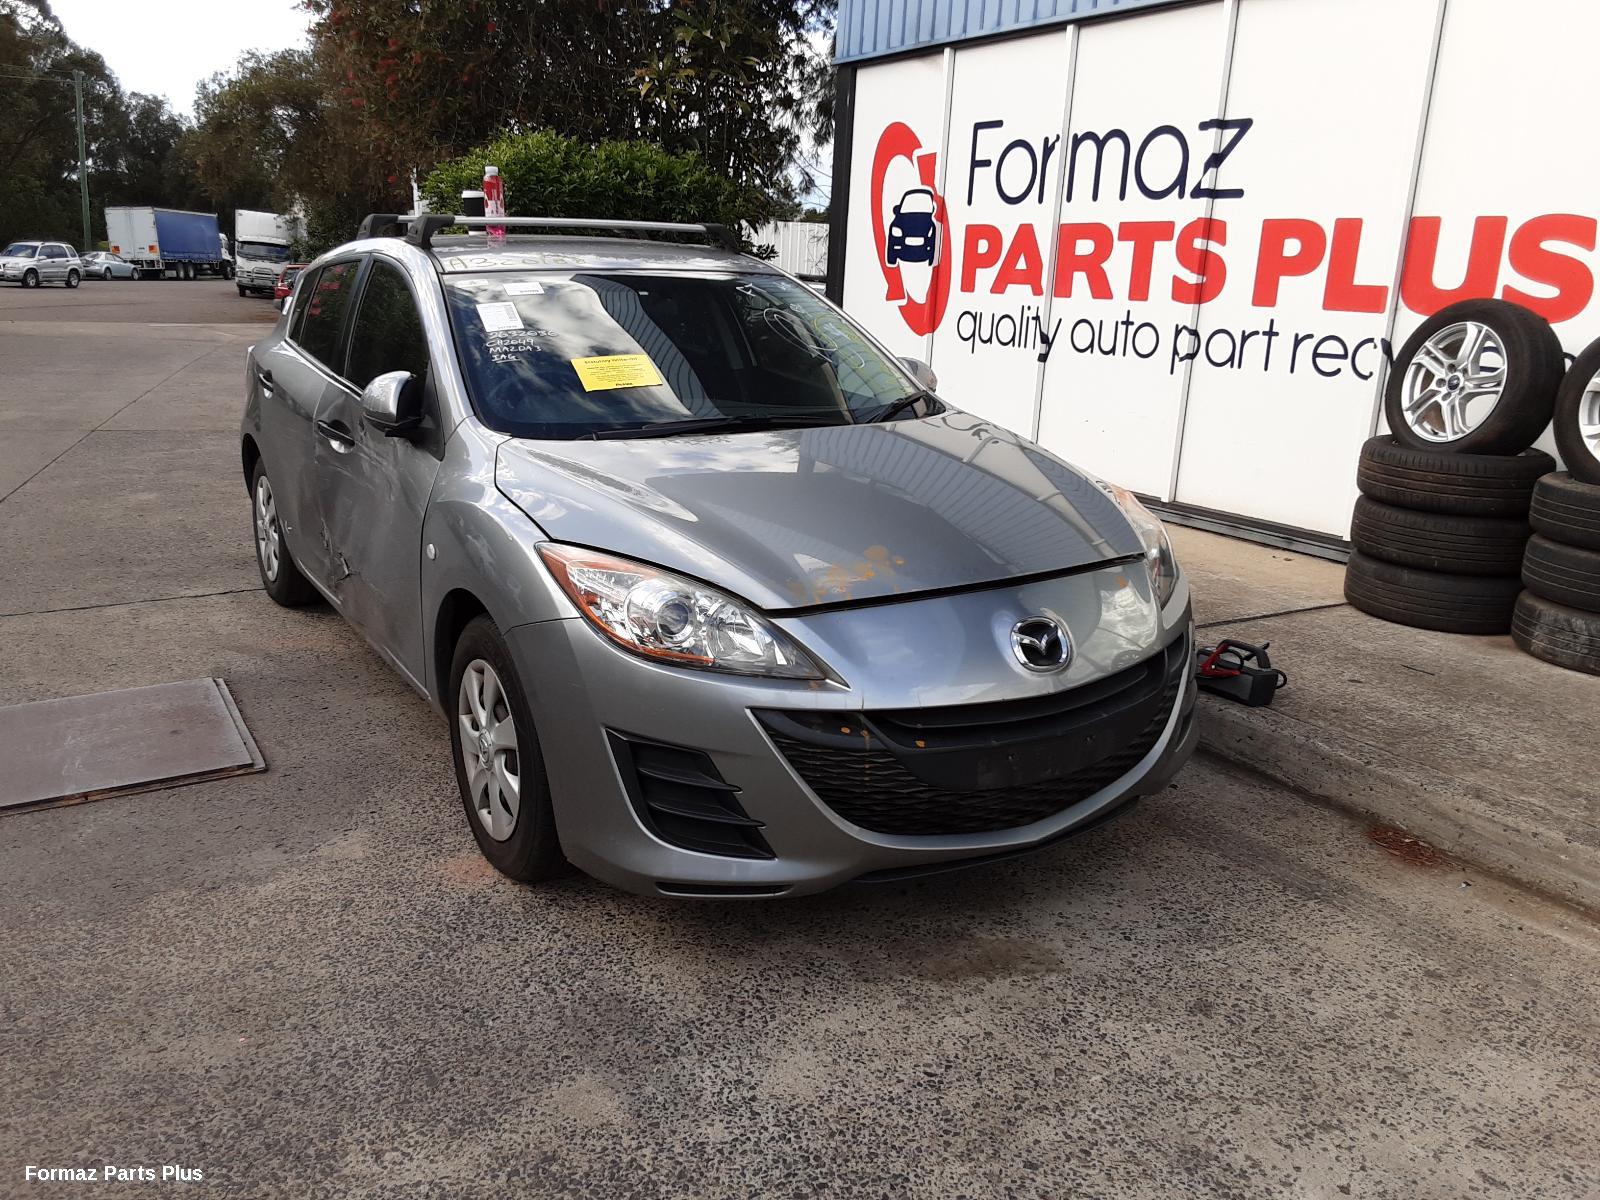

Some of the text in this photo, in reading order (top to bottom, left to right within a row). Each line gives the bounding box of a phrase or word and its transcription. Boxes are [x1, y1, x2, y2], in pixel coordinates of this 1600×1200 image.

[967, 118, 1253, 206] Formaz
[960, 213, 1598, 324] PARTS PLUS
[957, 305, 1062, 362] quality
[1070, 309, 1160, 359] auto
[1170, 318, 1279, 375] part
